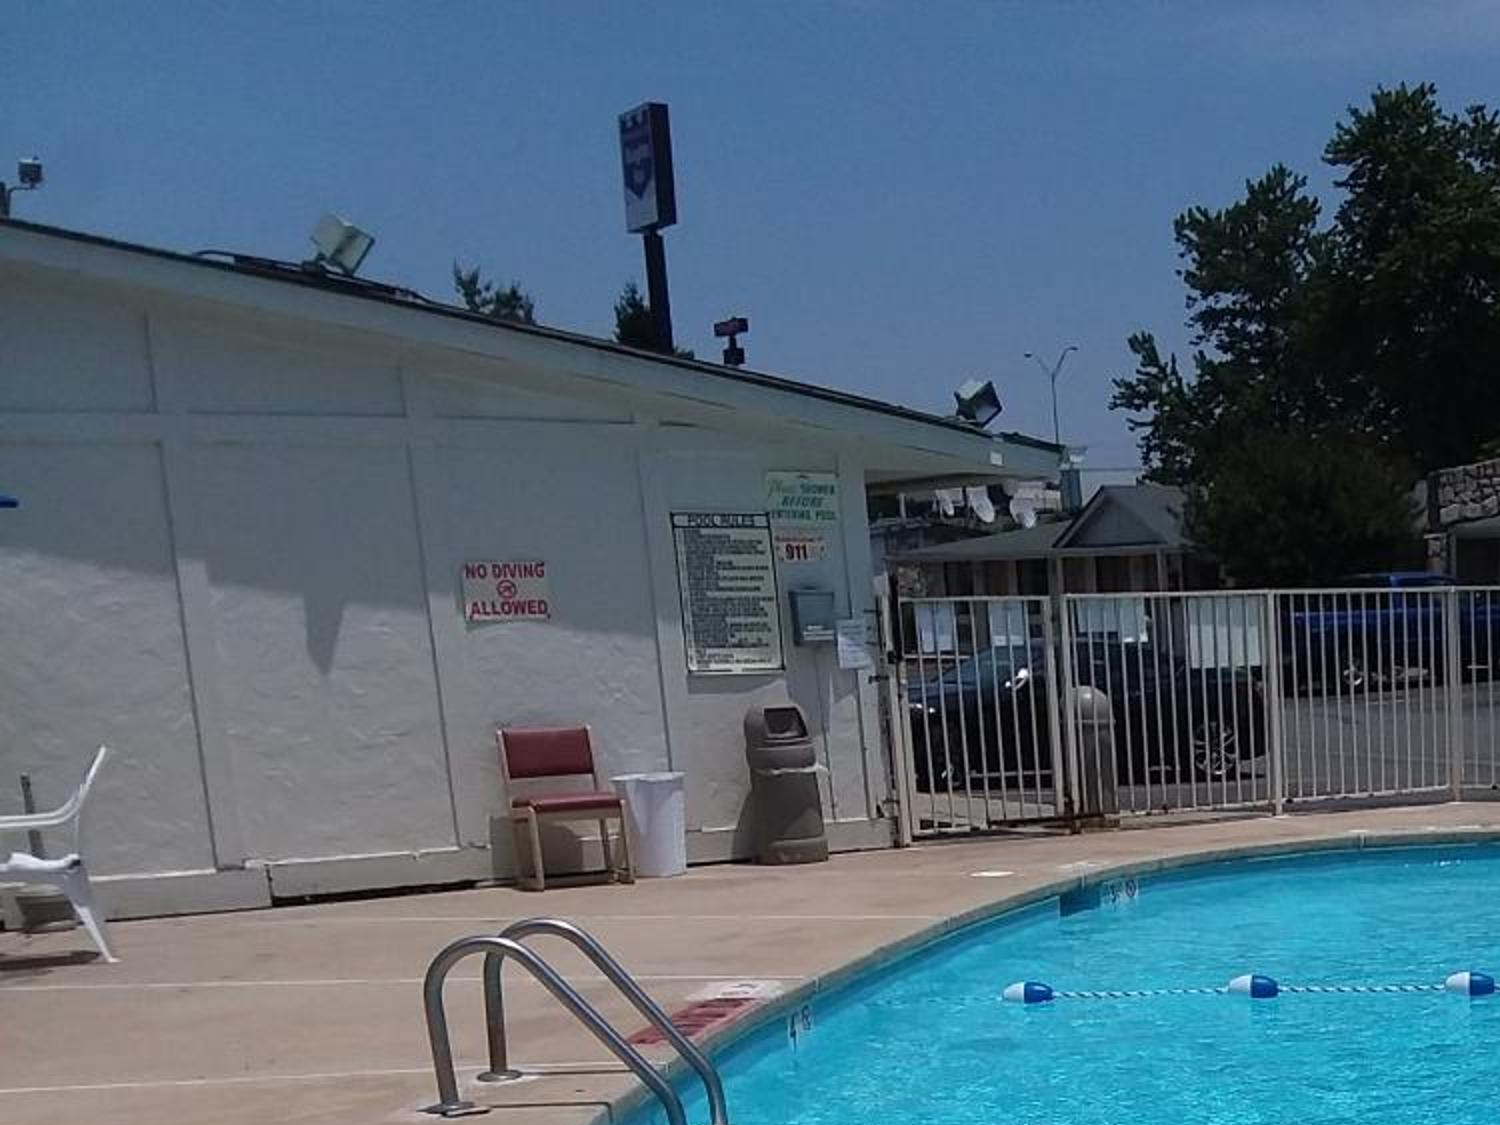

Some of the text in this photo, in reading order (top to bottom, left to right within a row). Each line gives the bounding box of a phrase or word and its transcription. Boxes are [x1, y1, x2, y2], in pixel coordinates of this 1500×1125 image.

[785, 543, 808, 561] 911
[465, 562, 545, 578] NO DIVING
[471, 599, 549, 616] ALLOWED
